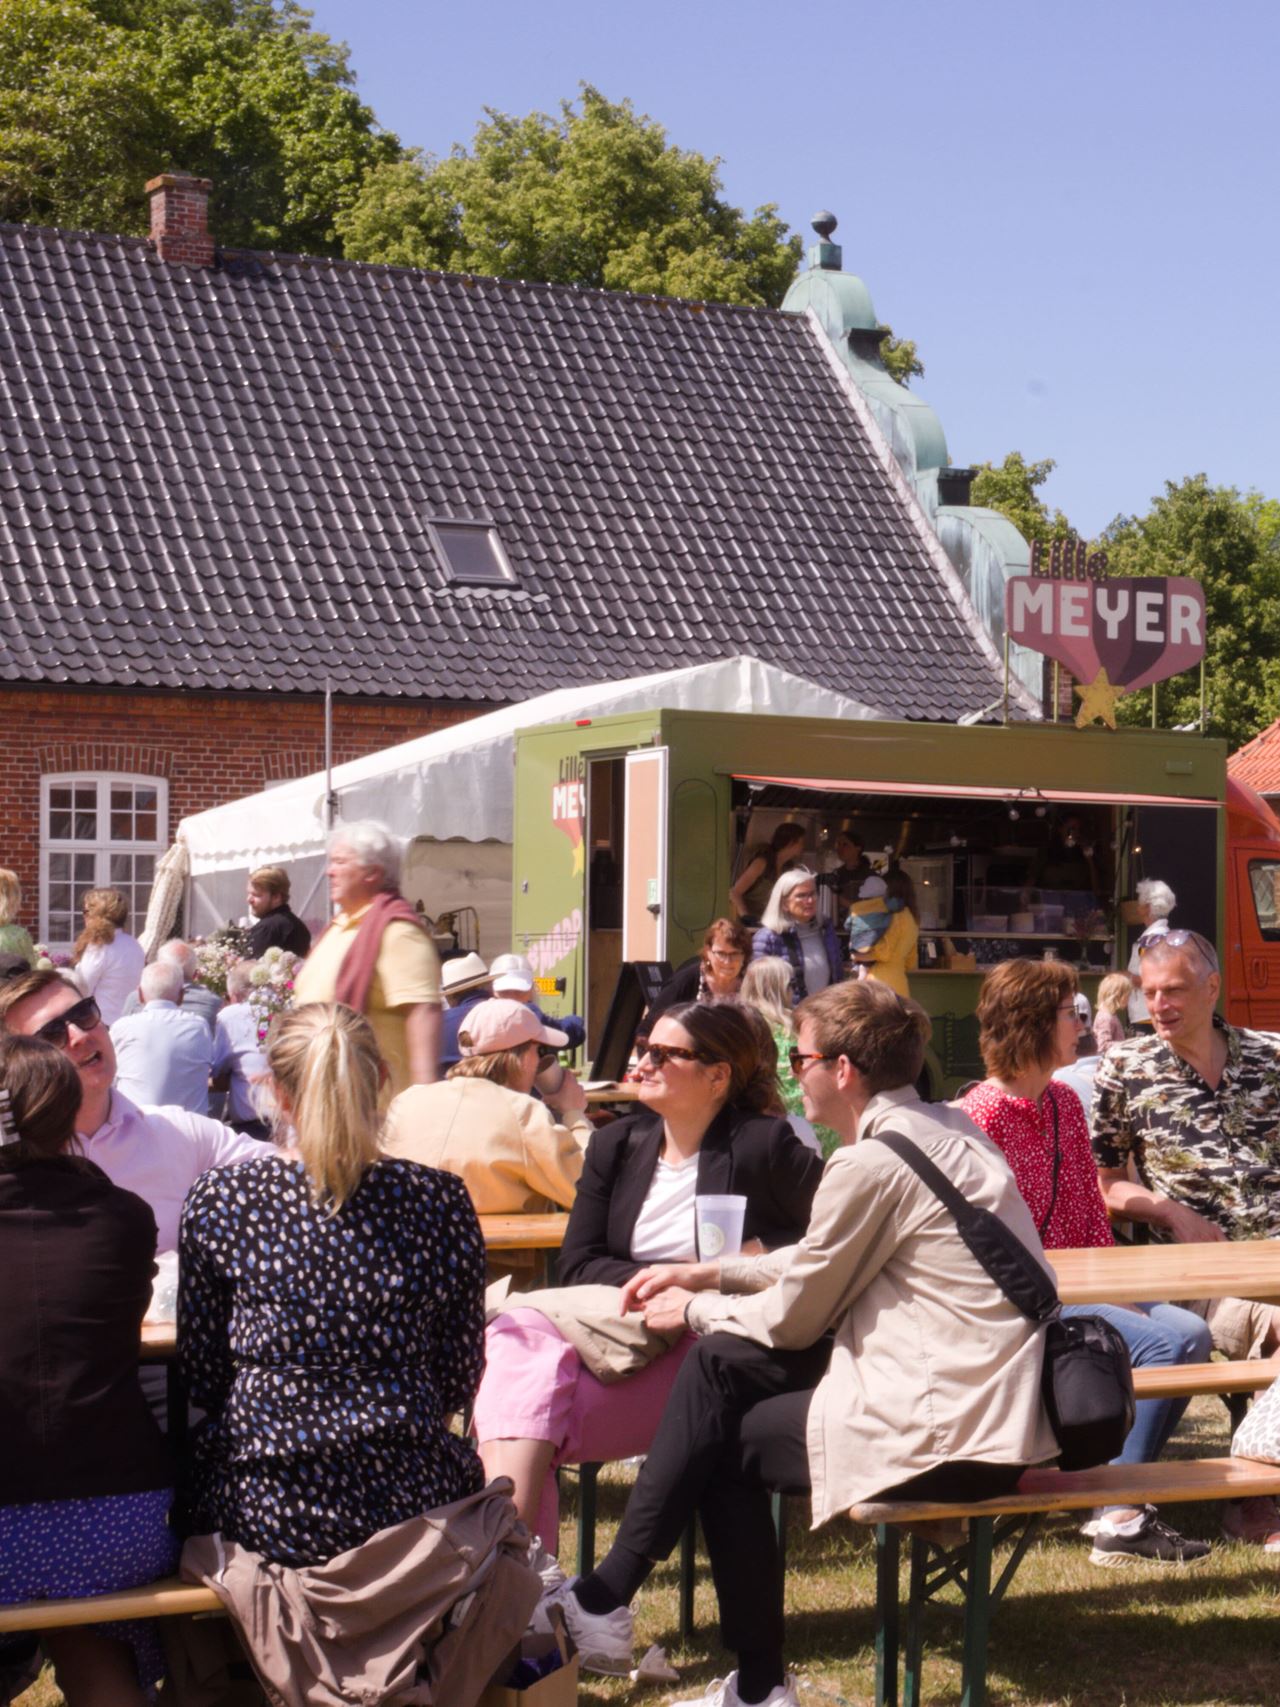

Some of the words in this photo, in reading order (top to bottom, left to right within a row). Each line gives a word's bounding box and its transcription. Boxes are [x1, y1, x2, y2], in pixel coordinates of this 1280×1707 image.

[1030, 539, 1108, 582] Lille
[1012, 581, 1202, 645] MEYER
[553, 784, 586, 820] MEY
